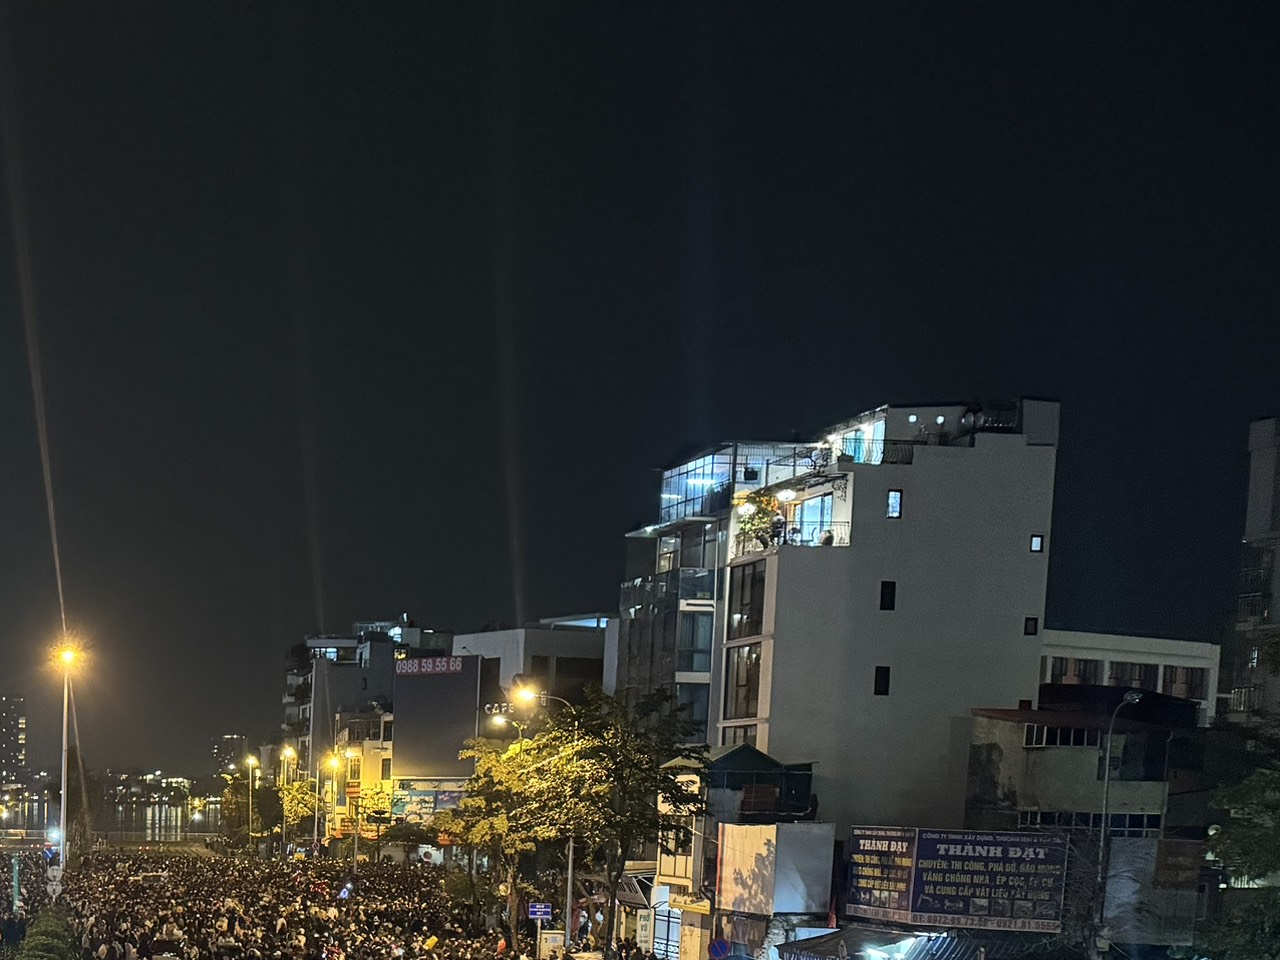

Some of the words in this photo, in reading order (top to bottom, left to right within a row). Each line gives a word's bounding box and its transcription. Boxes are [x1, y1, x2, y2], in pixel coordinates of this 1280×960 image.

[395, 659, 419, 673] 0988
[420, 658, 433, 671] 59
[434, 657, 447, 671] 55
[449, 657, 462, 670] 66
[484, 703, 515, 714] CAFE
[859, 838, 888, 851] THÀNH
[936, 843, 1002, 857] THÀNH
[1007, 846, 1049, 860] ĐẠT
